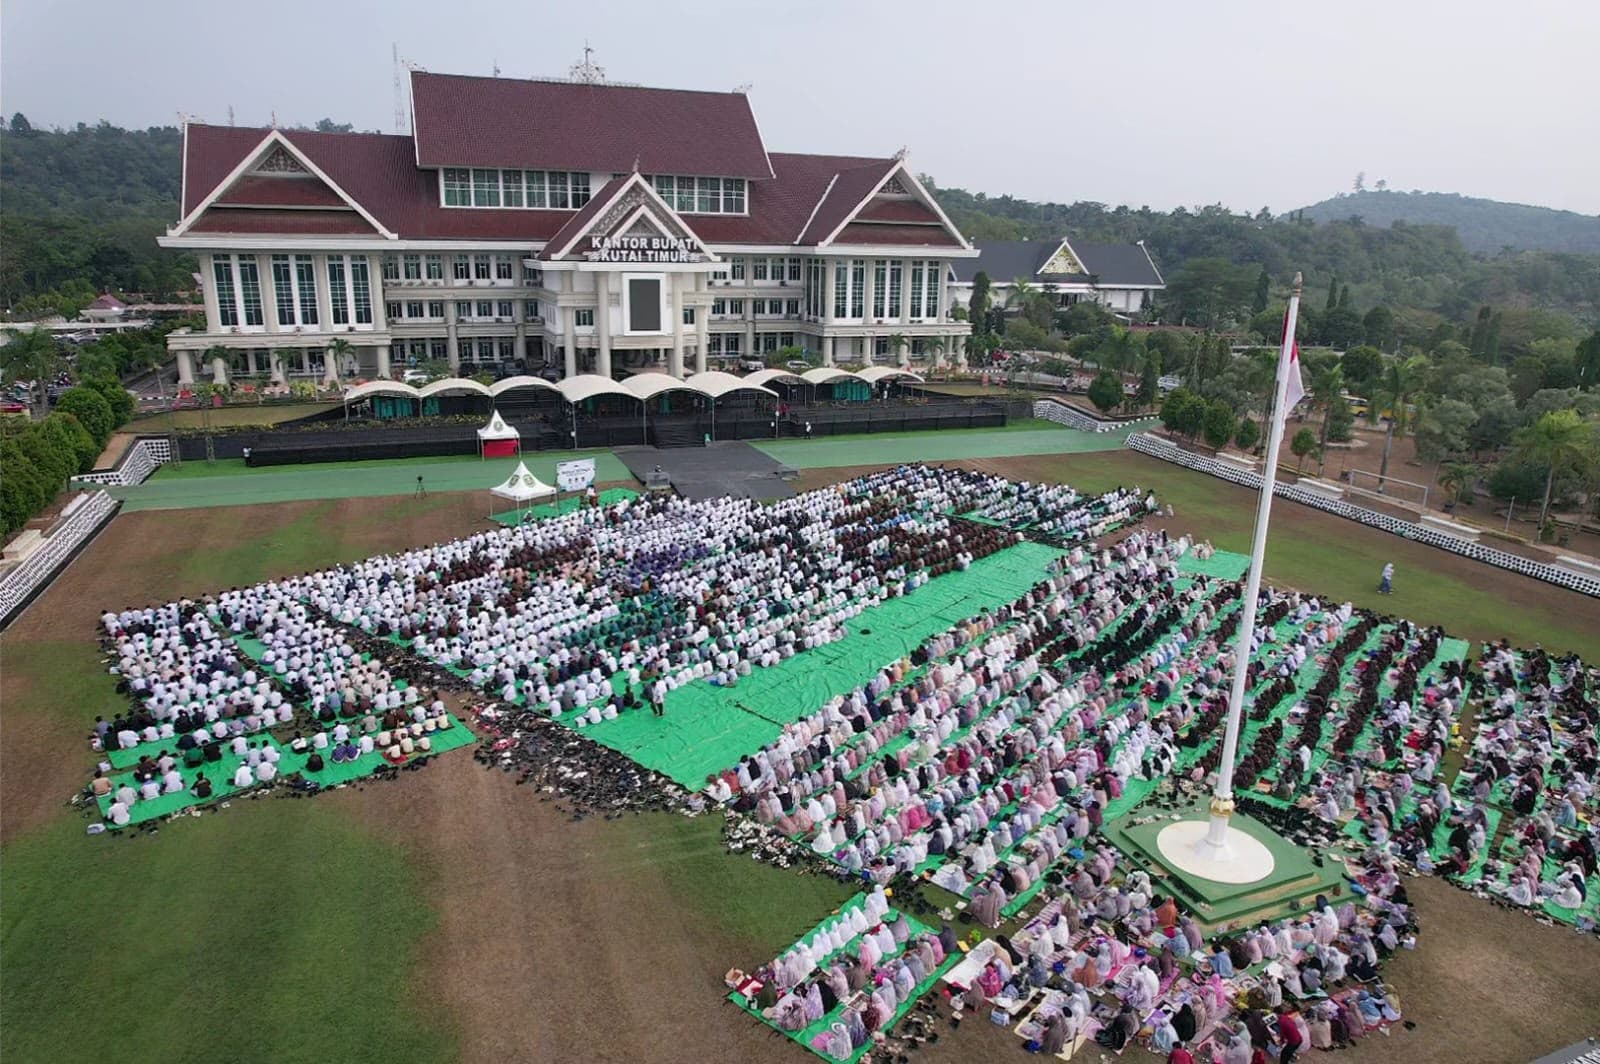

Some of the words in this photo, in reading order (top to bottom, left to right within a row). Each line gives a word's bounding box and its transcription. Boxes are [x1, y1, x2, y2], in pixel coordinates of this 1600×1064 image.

[591, 236, 648, 249] KANTOR
[652, 237, 700, 250] BUPATI
[601, 250, 642, 262] KUTAI
[645, 250, 688, 262] TIMUR
